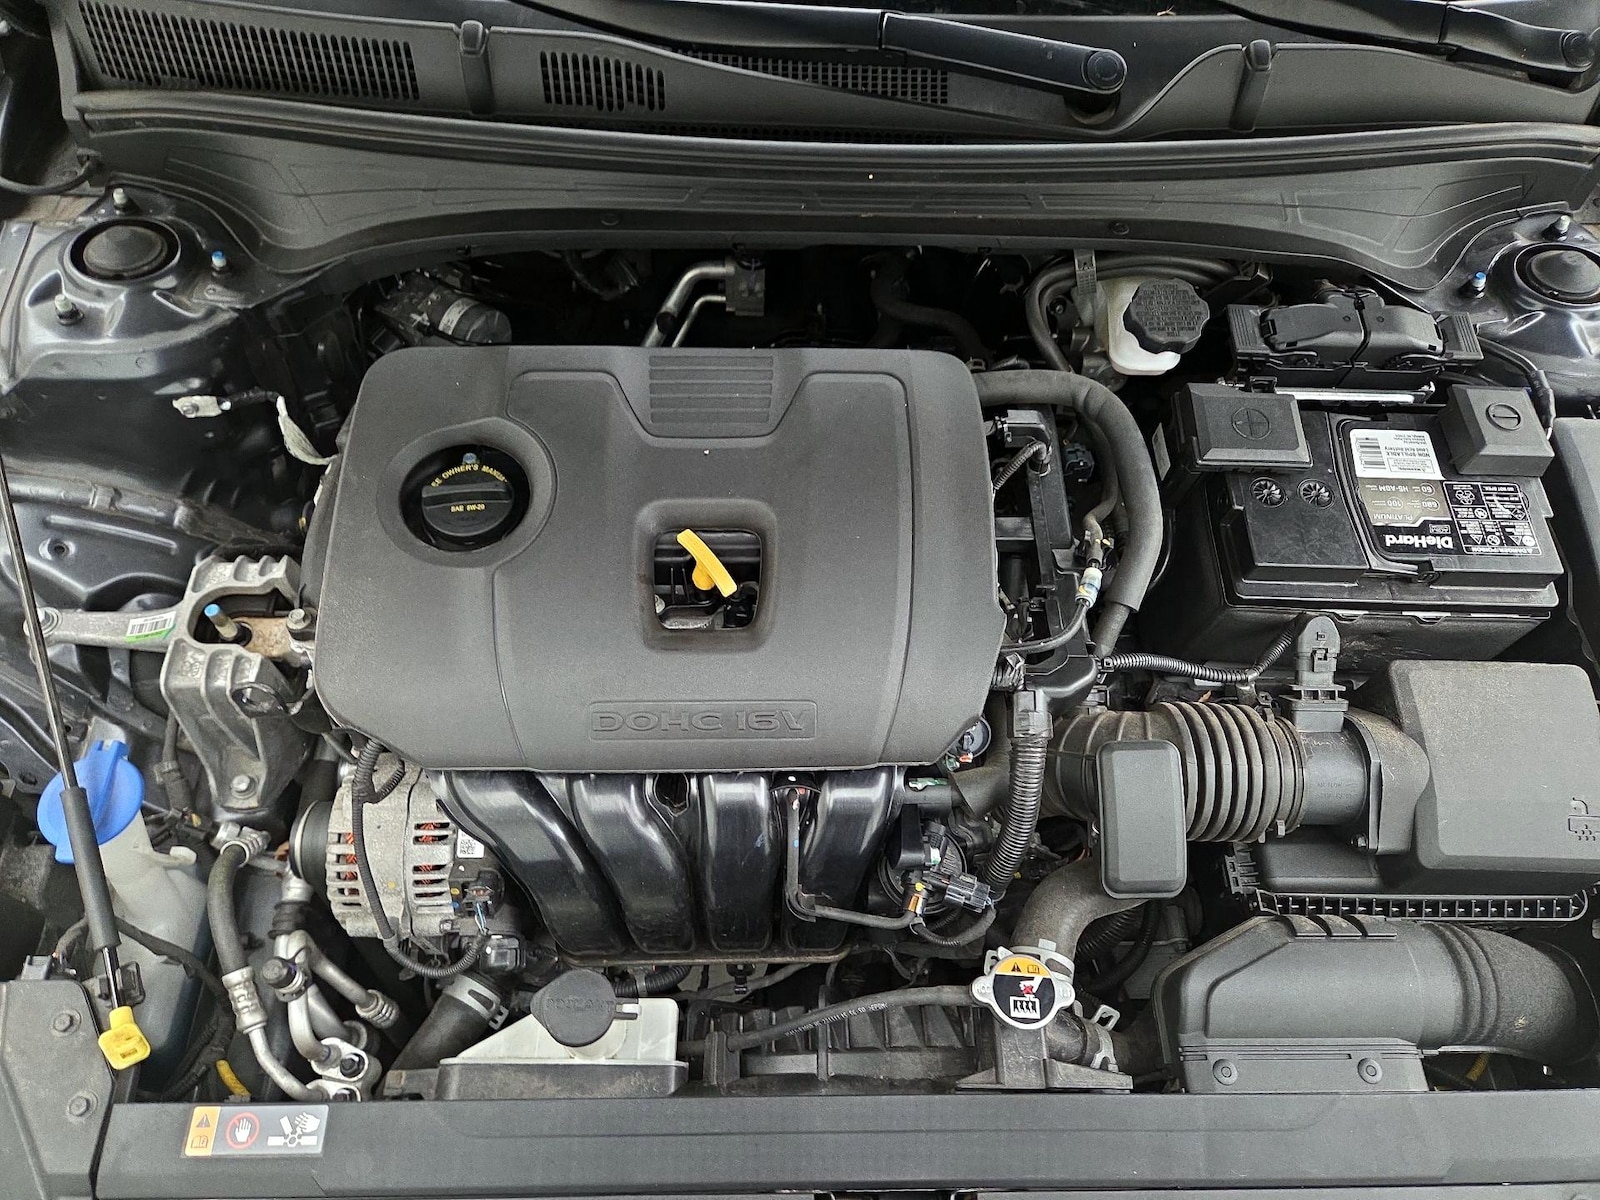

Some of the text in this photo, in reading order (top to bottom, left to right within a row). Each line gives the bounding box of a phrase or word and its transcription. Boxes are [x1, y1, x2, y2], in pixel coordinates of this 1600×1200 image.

[442, 463, 479, 480] OWNER'S
[1387, 499, 1402, 507] 100
[1373, 513, 1413, 521] PLATINUM
[1386, 534, 1453, 549] DieHard
[592, 709, 814, 732] DOHC 16V
